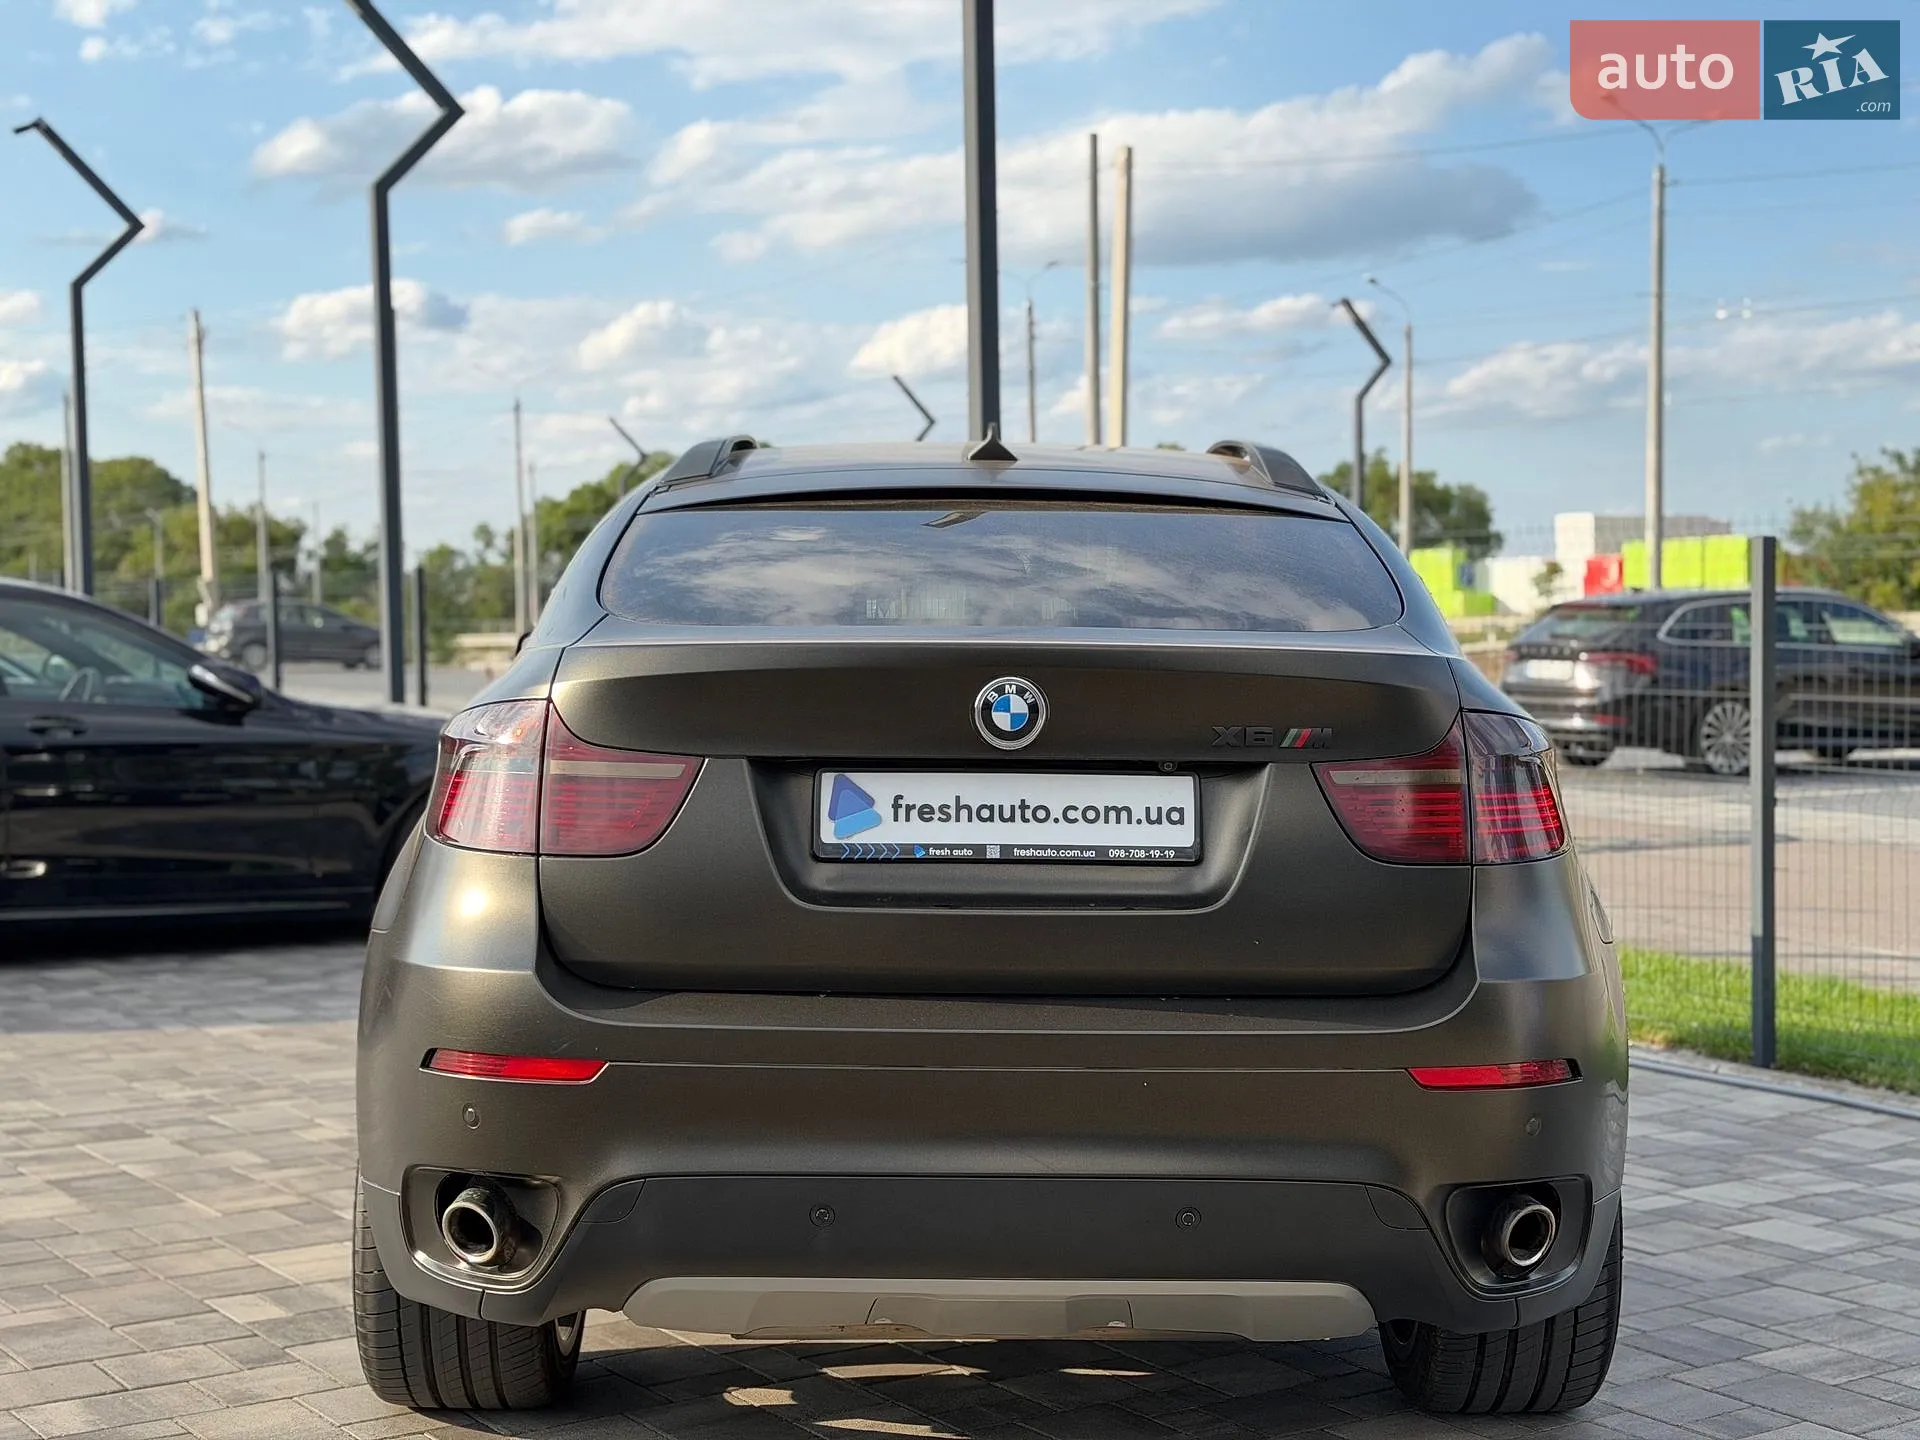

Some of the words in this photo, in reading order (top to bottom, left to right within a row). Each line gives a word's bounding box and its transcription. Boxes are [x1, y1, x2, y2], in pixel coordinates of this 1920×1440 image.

[986, 684, 1036, 704] BMW
[1211, 726, 1274, 747] X6
[891, 794, 1185, 825] freshauto.com.ua
[929, 846, 950, 856] fresh
[952, 846, 973, 856] auto
[1013, 847, 1096, 859] freshauto.com.ua
[1108, 849, 1176, 860] 098-708-19-19
